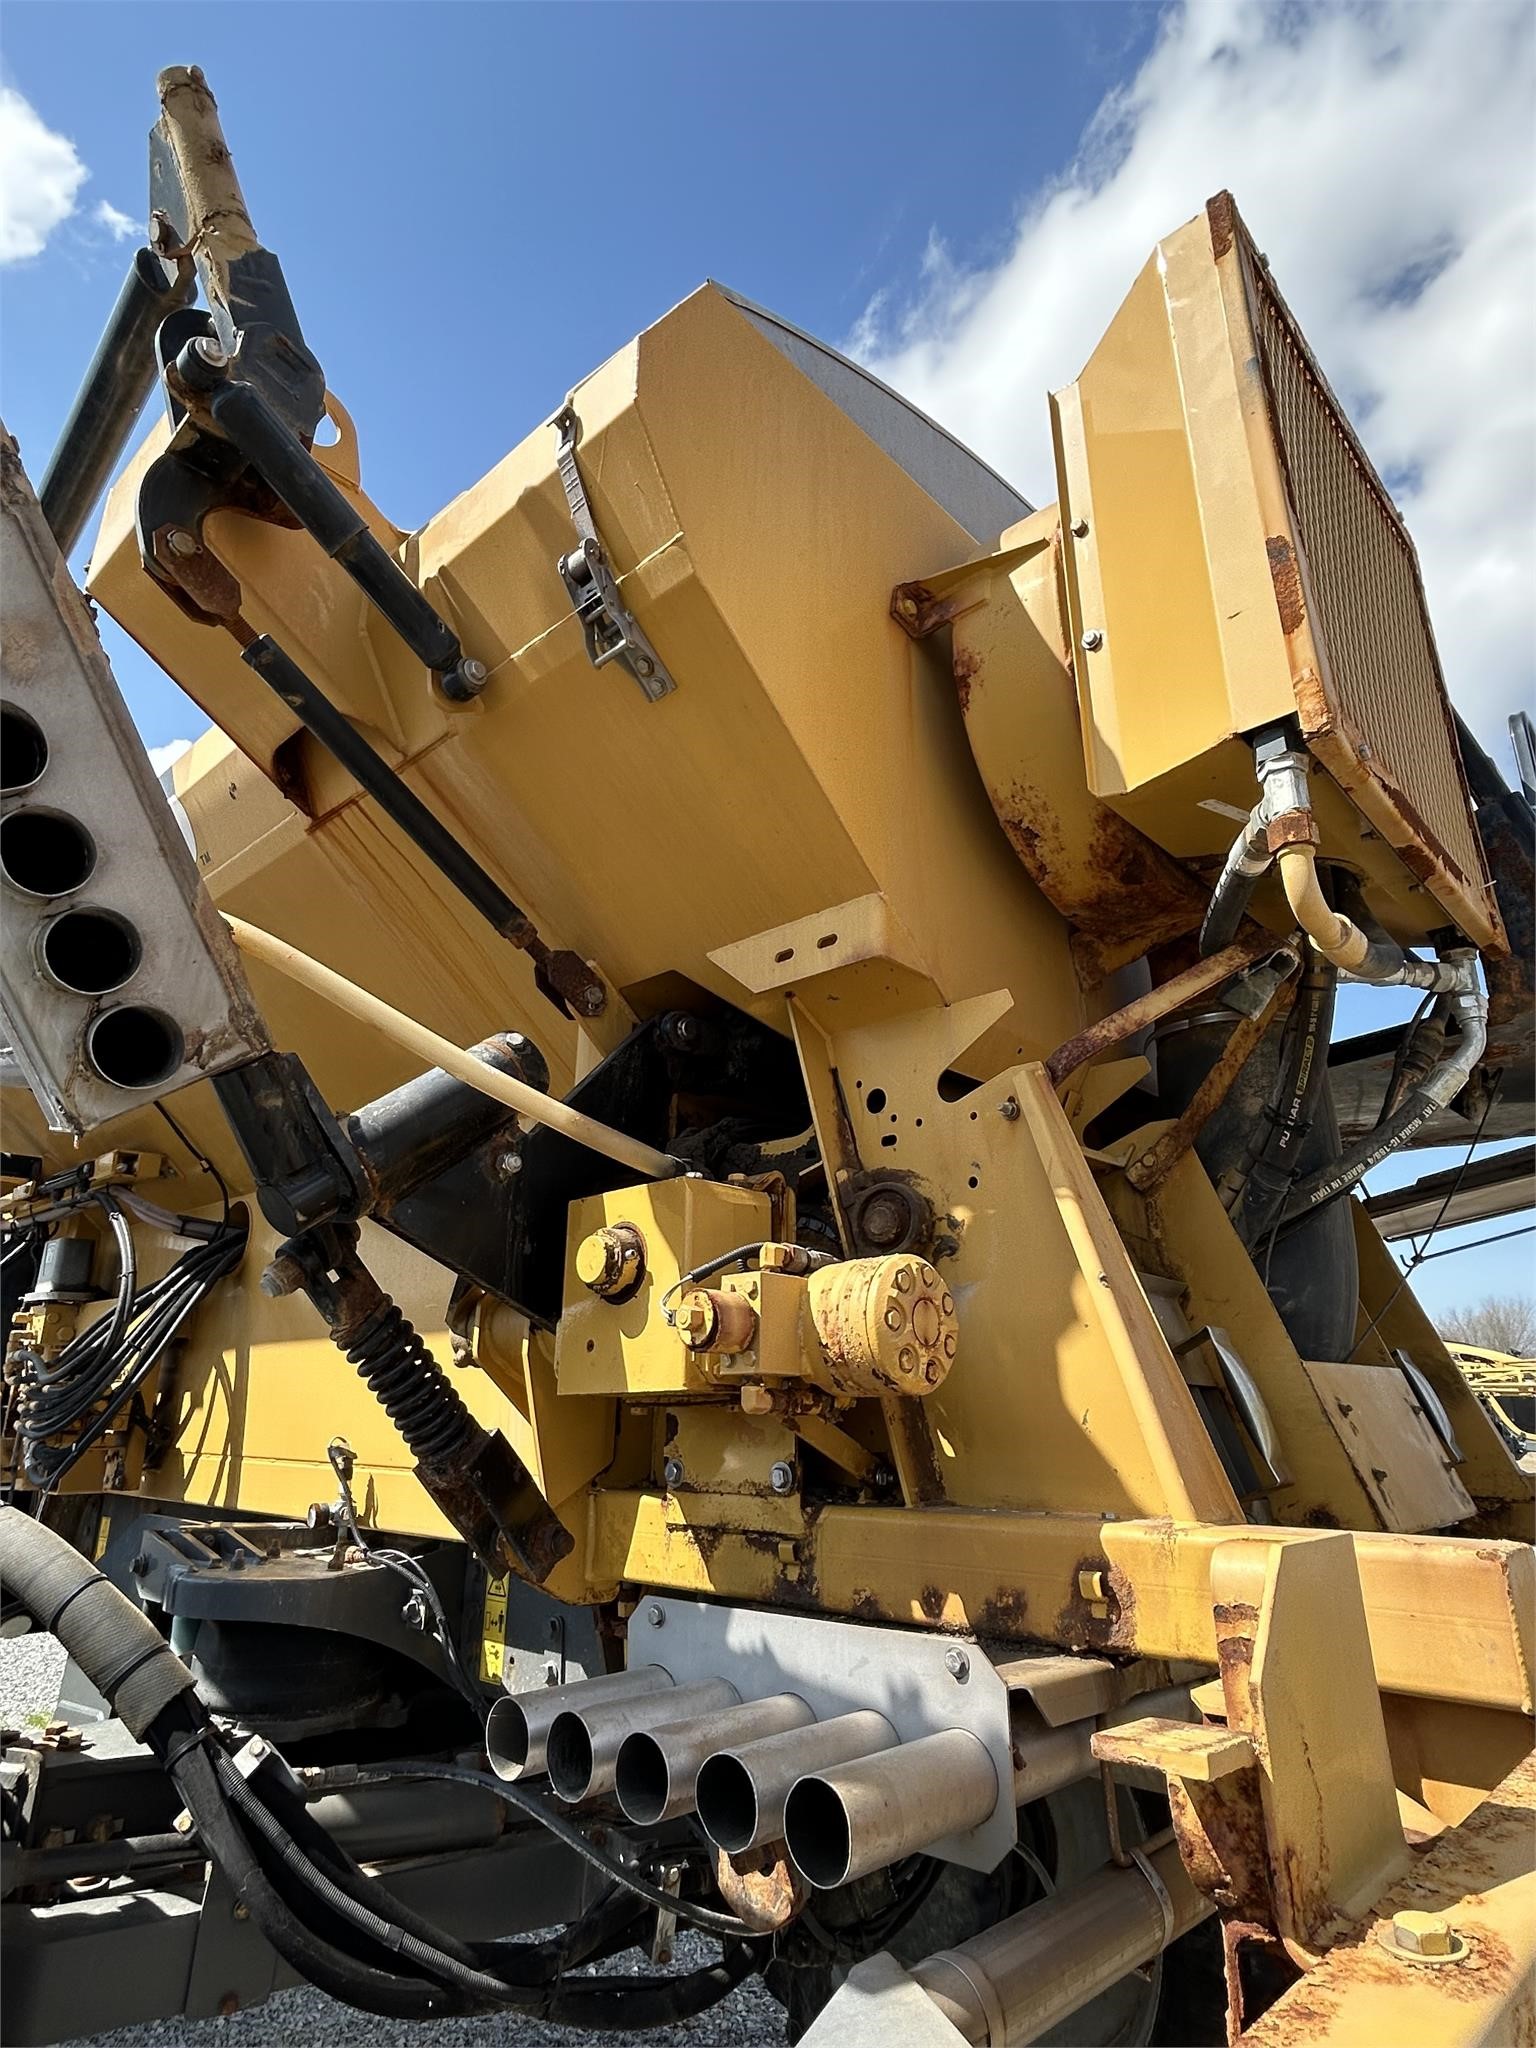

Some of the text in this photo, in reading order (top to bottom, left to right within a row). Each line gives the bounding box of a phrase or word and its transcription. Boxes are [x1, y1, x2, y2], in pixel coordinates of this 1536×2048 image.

[199, 851, 212, 866] TM
[1341, 1163, 1366, 1184] MADE
[1329, 1177, 1343, 1190] IN
[1309, 1184, 1331, 1203] ITALY
